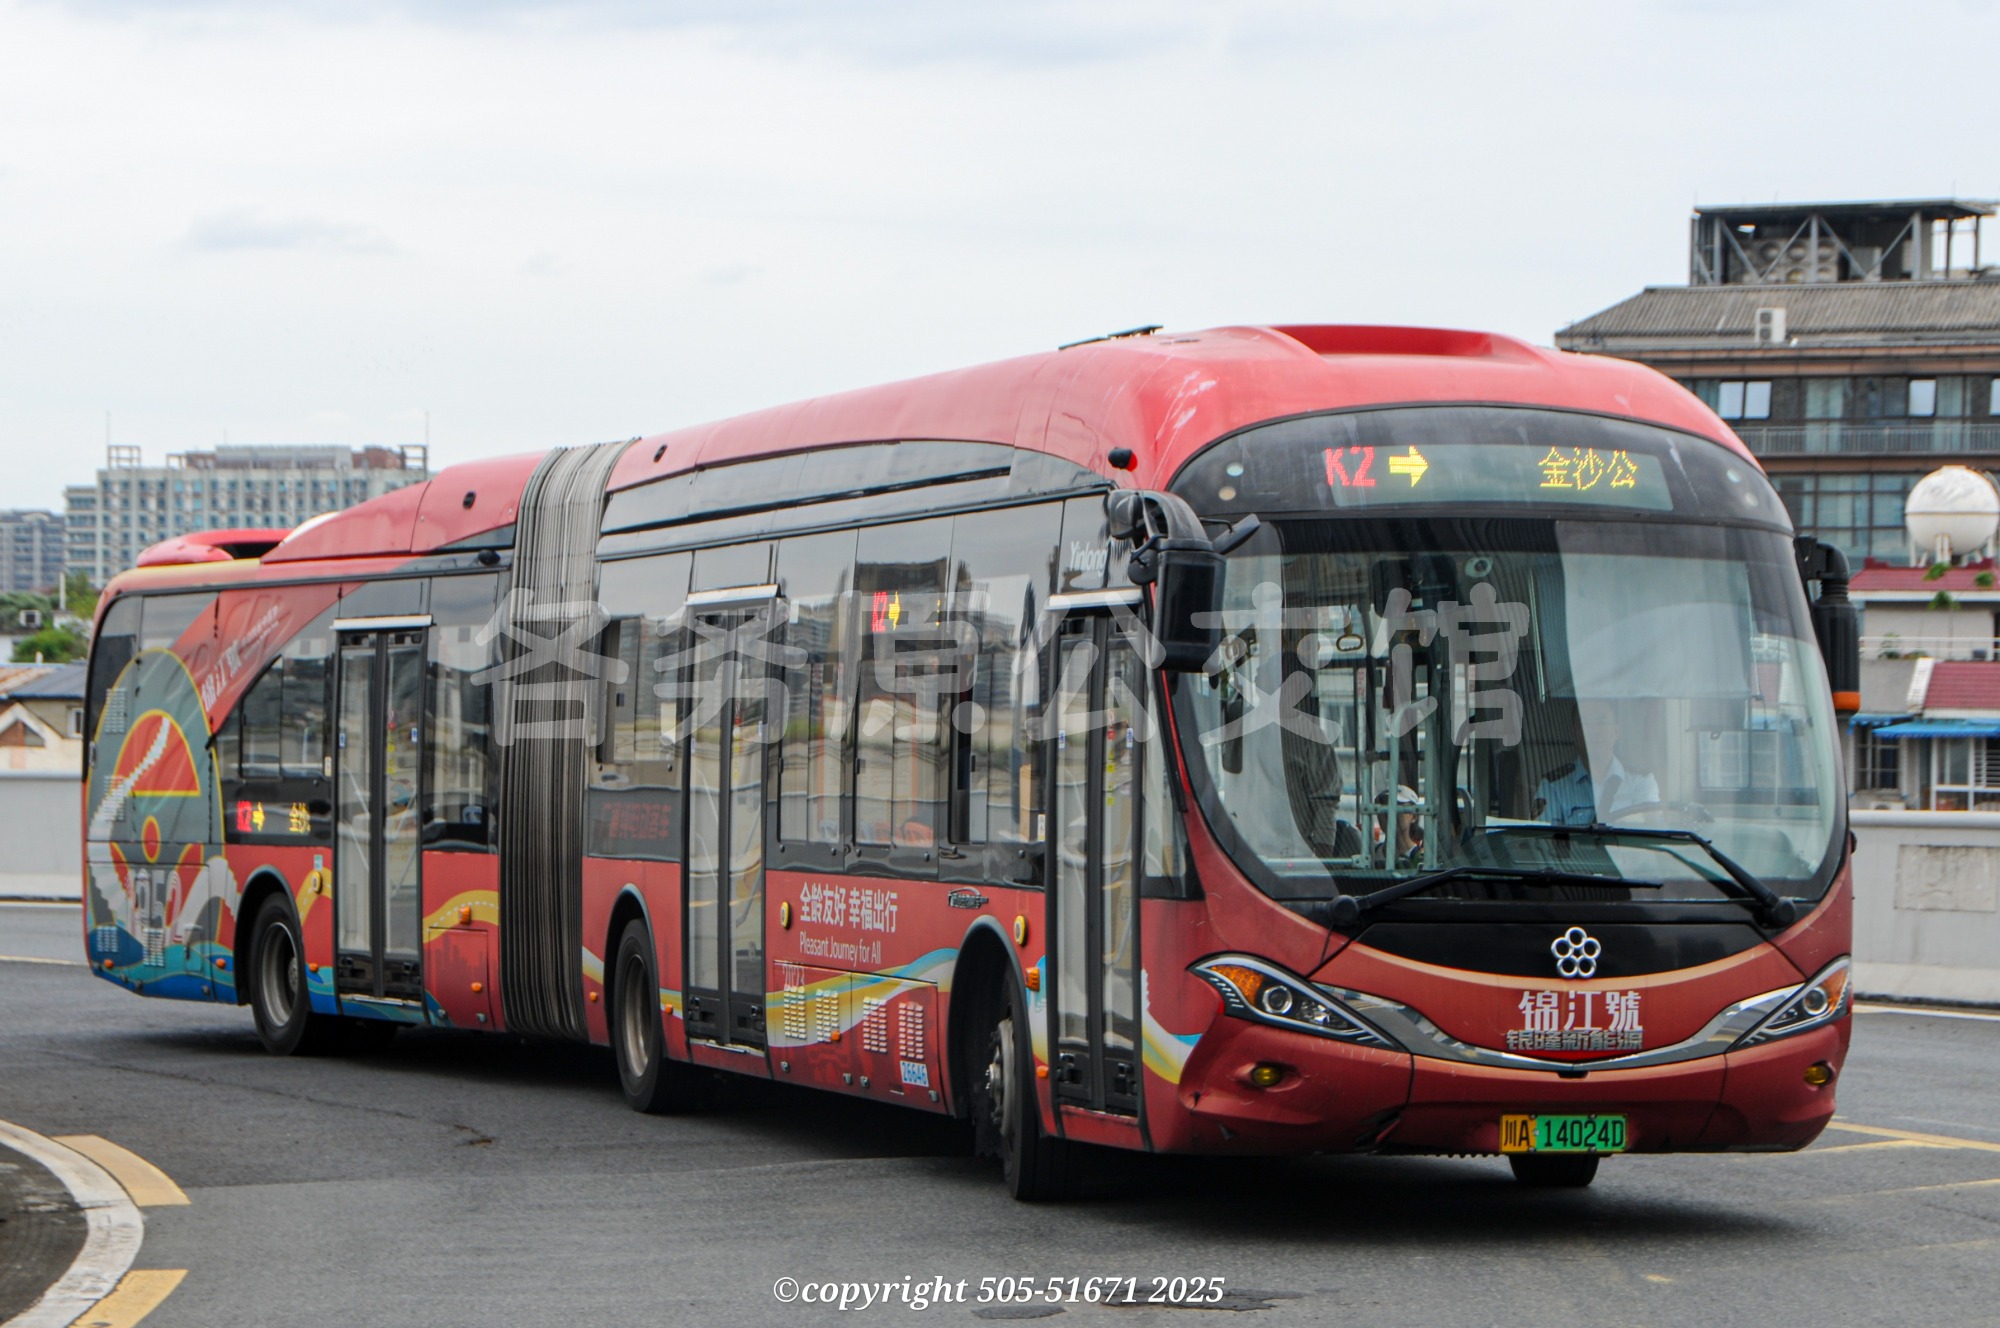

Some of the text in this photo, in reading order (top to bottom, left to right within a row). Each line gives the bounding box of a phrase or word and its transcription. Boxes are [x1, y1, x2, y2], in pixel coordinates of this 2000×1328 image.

[1325, 446, 1376, 487] K2
[1538, 446, 1638, 490] 金沙公
[1069, 540, 1107, 578] Yinlong
[800, 881, 846, 927] 全龄友好
[849, 887, 898, 933] 幸福出行
[800, 931, 881, 967] Pleasant Journey for All
[1507, 1030, 1643, 1050] 银隆新能源
[902, 1062, 927, 1085] 26646
